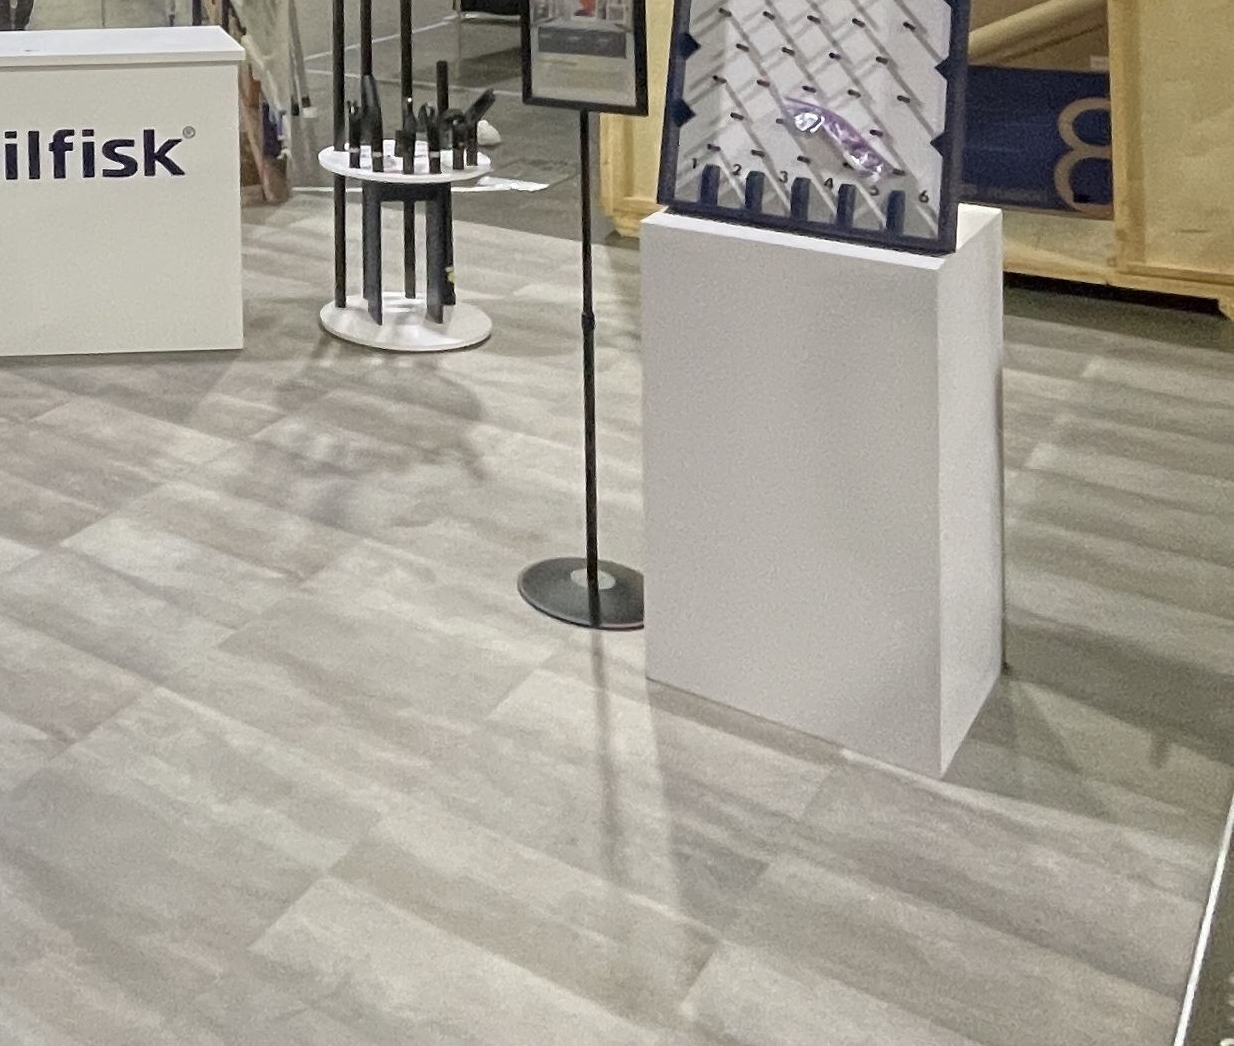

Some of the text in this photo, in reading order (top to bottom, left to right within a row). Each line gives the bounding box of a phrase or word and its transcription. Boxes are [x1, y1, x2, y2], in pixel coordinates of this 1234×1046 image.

[690, 158, 698, 170] 1
[731, 163, 742, 176] 2
[778, 170, 789, 184] 3
[822, 177, 835, 191] 4
[918, 189, 930, 204] 6
